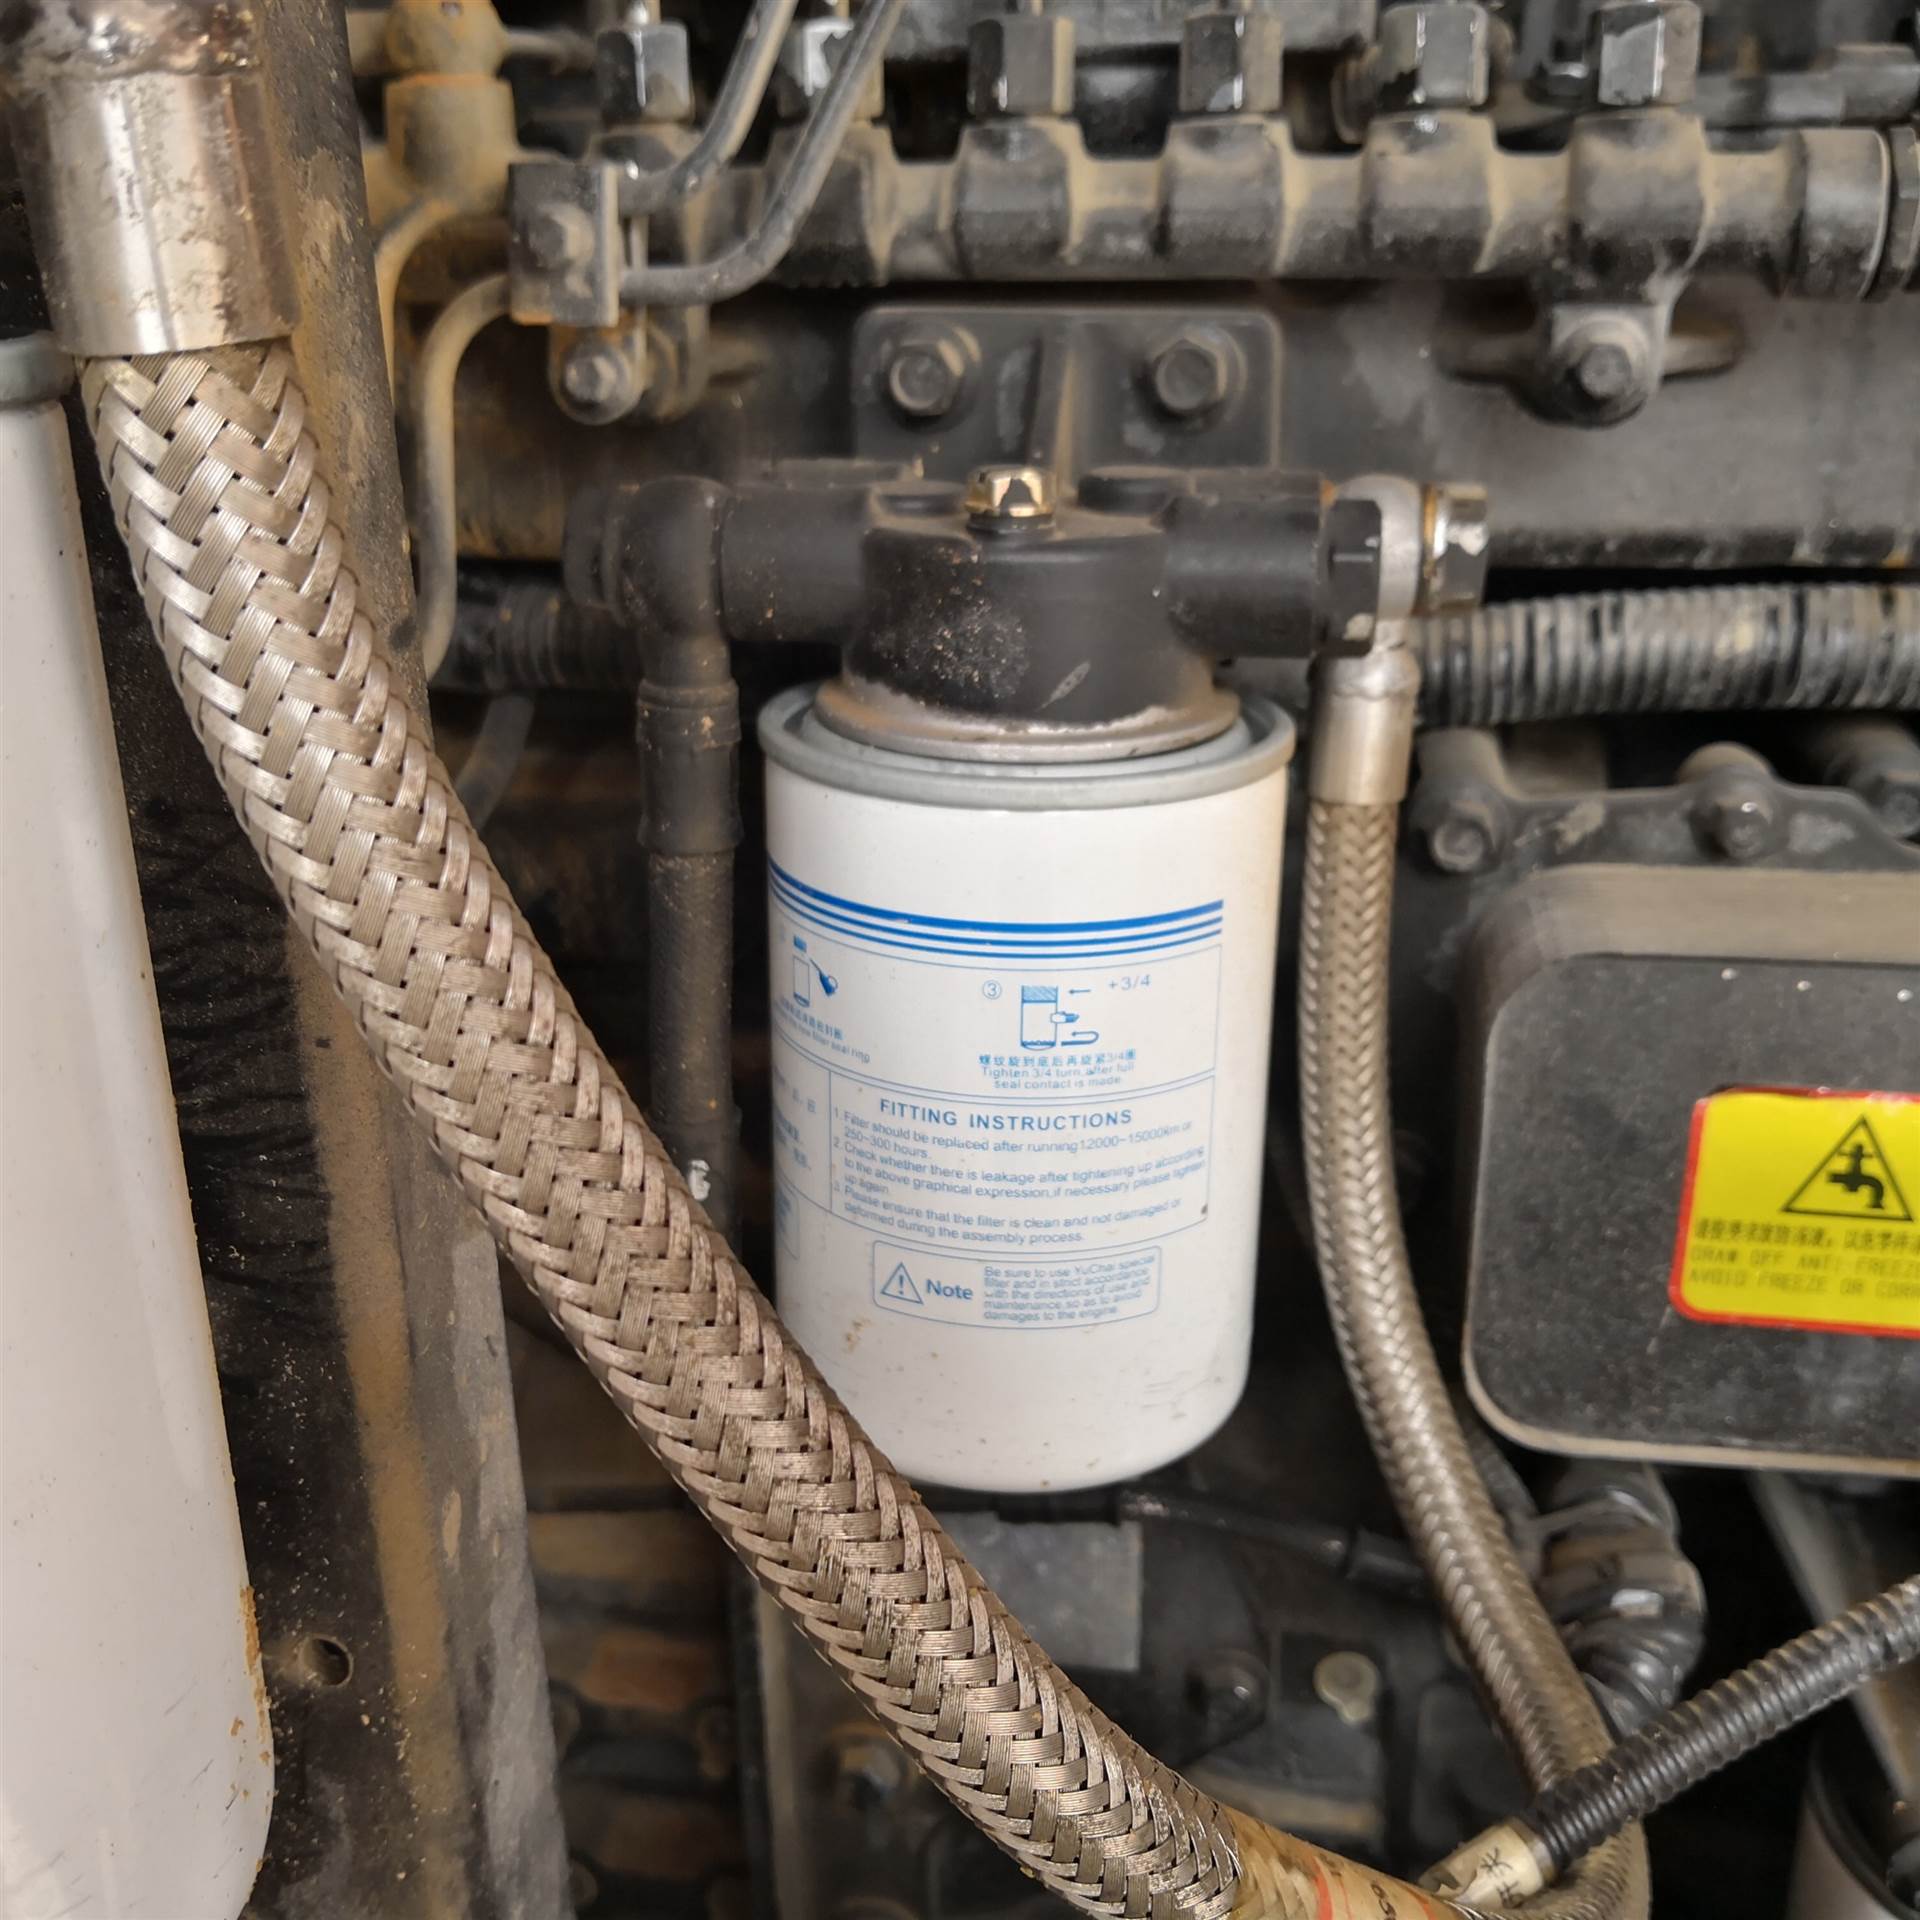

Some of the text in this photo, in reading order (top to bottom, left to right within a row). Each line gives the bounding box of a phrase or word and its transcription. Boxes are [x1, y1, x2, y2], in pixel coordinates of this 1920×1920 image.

[1108, 974, 1151, 991] +3/4
[851, 1048, 871, 1064] ring
[982, 1067, 1029, 1080] Tighten
[1032, 1067, 1052, 1078] 3/4
[1116, 1061, 1135, 1072] full
[994, 1078, 1021, 1089] seal
[1024, 1078, 1072, 1090] contact
[1074, 1078, 1085, 1088] is
[879, 1098, 1132, 1131] FITTING INSTRUCTIONS
[844, 1110, 870, 1129] Filter
[872, 1121, 911, 1140] should
[913, 1129, 929, 1144] be
[932, 1136, 989, 1152] replaced
[993, 1139, 1023, 1152] after
[1182, 1120, 1193, 1132] or
[844, 1142, 876, 1161] Check
[880, 1154, 927, 1174] whether
[930, 1163, 964, 1180] there
[967, 1169, 978, 1181] is
[981, 1170, 1036, 1185] leakage
[1039, 1171, 1069, 1184] after
[1072, 1165, 1135, 1184] tightening
[1138, 1162, 1154, 1174] up
[1155, 1146, 1206, 1169] according
[844, 1157, 855, 1170] to
[856, 1160, 873, 1176] the
[875, 1166, 910, 1185] above
[913, 1177, 972, 1196] graphical
[1065, 1180, 1130, 1199] necessary
[1132, 1172, 1171, 1191] please
[844, 1174, 857, 1188] up
[844, 1185, 880, 1208] Please
[882, 1200, 923, 1218] ensure
[926, 1207, 951, 1222] that
[954, 1211, 974, 1226] the
[977, 1214, 1006, 1228] filter
[1009, 1215, 1021, 1228] is
[1023, 1216, 1060, 1229] clean
[1063, 1213, 1089, 1228] and
[1092, 1211, 1112, 1224] not
[1114, 1202, 1169, 1222] damaged
[1171, 1198, 1182, 1209] or
[844, 1201, 894, 1226] deformed
[897, 1219, 936, 1238] during
[938, 1226, 959, 1240] the
[962, 1230, 1025, 1246] assembly
[984, 1265, 1001, 1278] Be
[1004, 1268, 1031, 1279] sure
[1034, 1268, 1047, 1279] to
[1049, 1268, 1071, 1279] use
[1118, 1257, 1155, 1271] special
[926, 1278, 974, 1301] Note
[984, 1277, 1010, 1289] filter
[1013, 1279, 1037, 1290] and
[1039, 1279, 1051, 1289] in
[984, 1276, 1151, 1300] with the directions of use and
[1065, 1299, 1081, 1309] so
[1083, 1298, 1098, 1308] as
[1100, 1294, 1111, 1305] to
[984, 1310, 1041, 1324] damages
[1043, 1310, 1056, 1321] to
[1057, 1308, 1077, 1320] the
